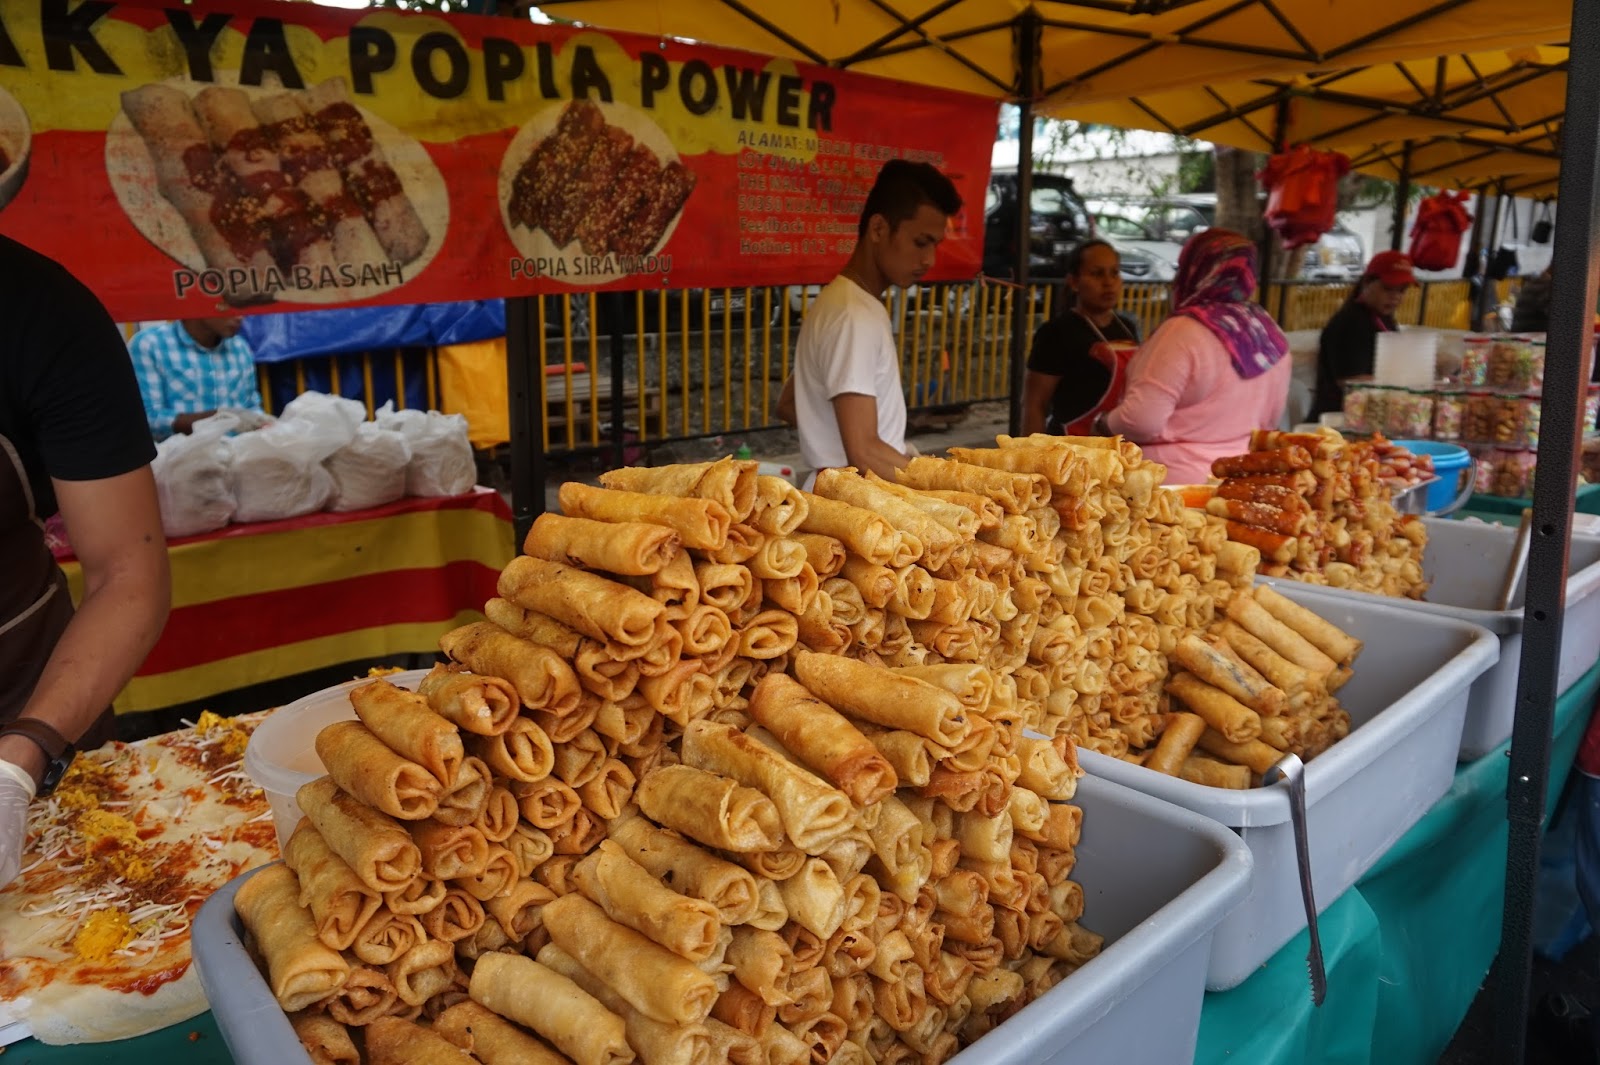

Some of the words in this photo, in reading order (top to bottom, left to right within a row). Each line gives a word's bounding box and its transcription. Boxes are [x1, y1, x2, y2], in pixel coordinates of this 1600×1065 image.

[165, 8, 305, 90] YA
[348, 26, 614, 104] POPIA
[639, 51, 837, 132] POWER
[738, 173, 766, 191] THE
[174, 268, 287, 299] POPIA
[292, 260, 405, 291] BASAH
[510, 255, 568, 280] POPIA
[573, 255, 615, 276] SIRA
[619, 253, 673, 275] MADU
